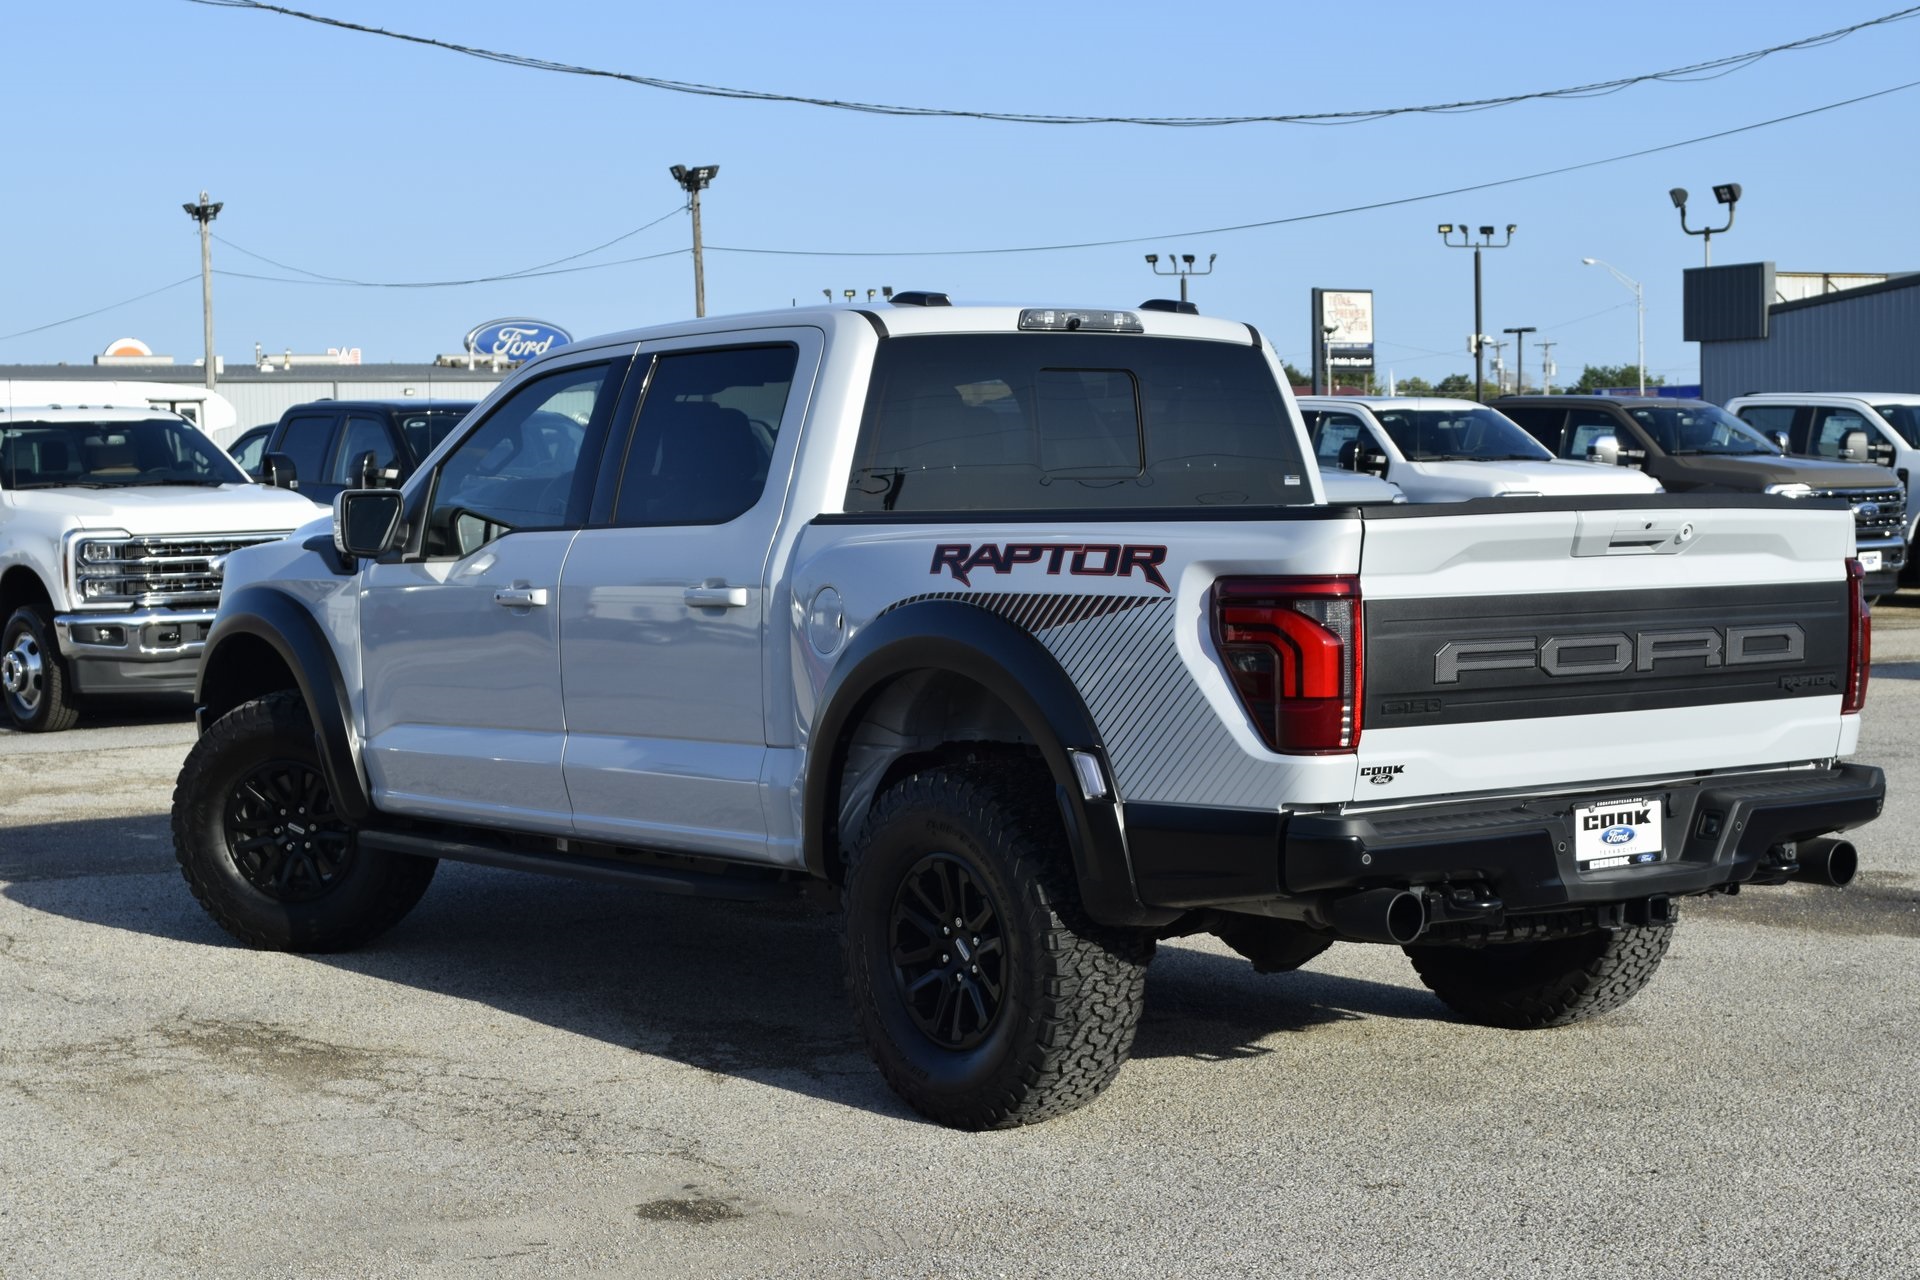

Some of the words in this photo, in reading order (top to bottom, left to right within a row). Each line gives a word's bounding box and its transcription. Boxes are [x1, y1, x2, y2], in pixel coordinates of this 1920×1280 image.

[493, 327, 554, 356] Ford
[929, 543, 1170, 593] RAPTOR
[1434, 622, 1806, 685] FORD
[1778, 672, 1838, 692] RAPTOR
[1360, 764, 1405, 776] COOK
[1583, 809, 1652, 831] COOK
[1606, 828, 1630, 843] Ford
[1589, 856, 1631, 870] COOK
[1640, 853, 1653, 862] Ford
